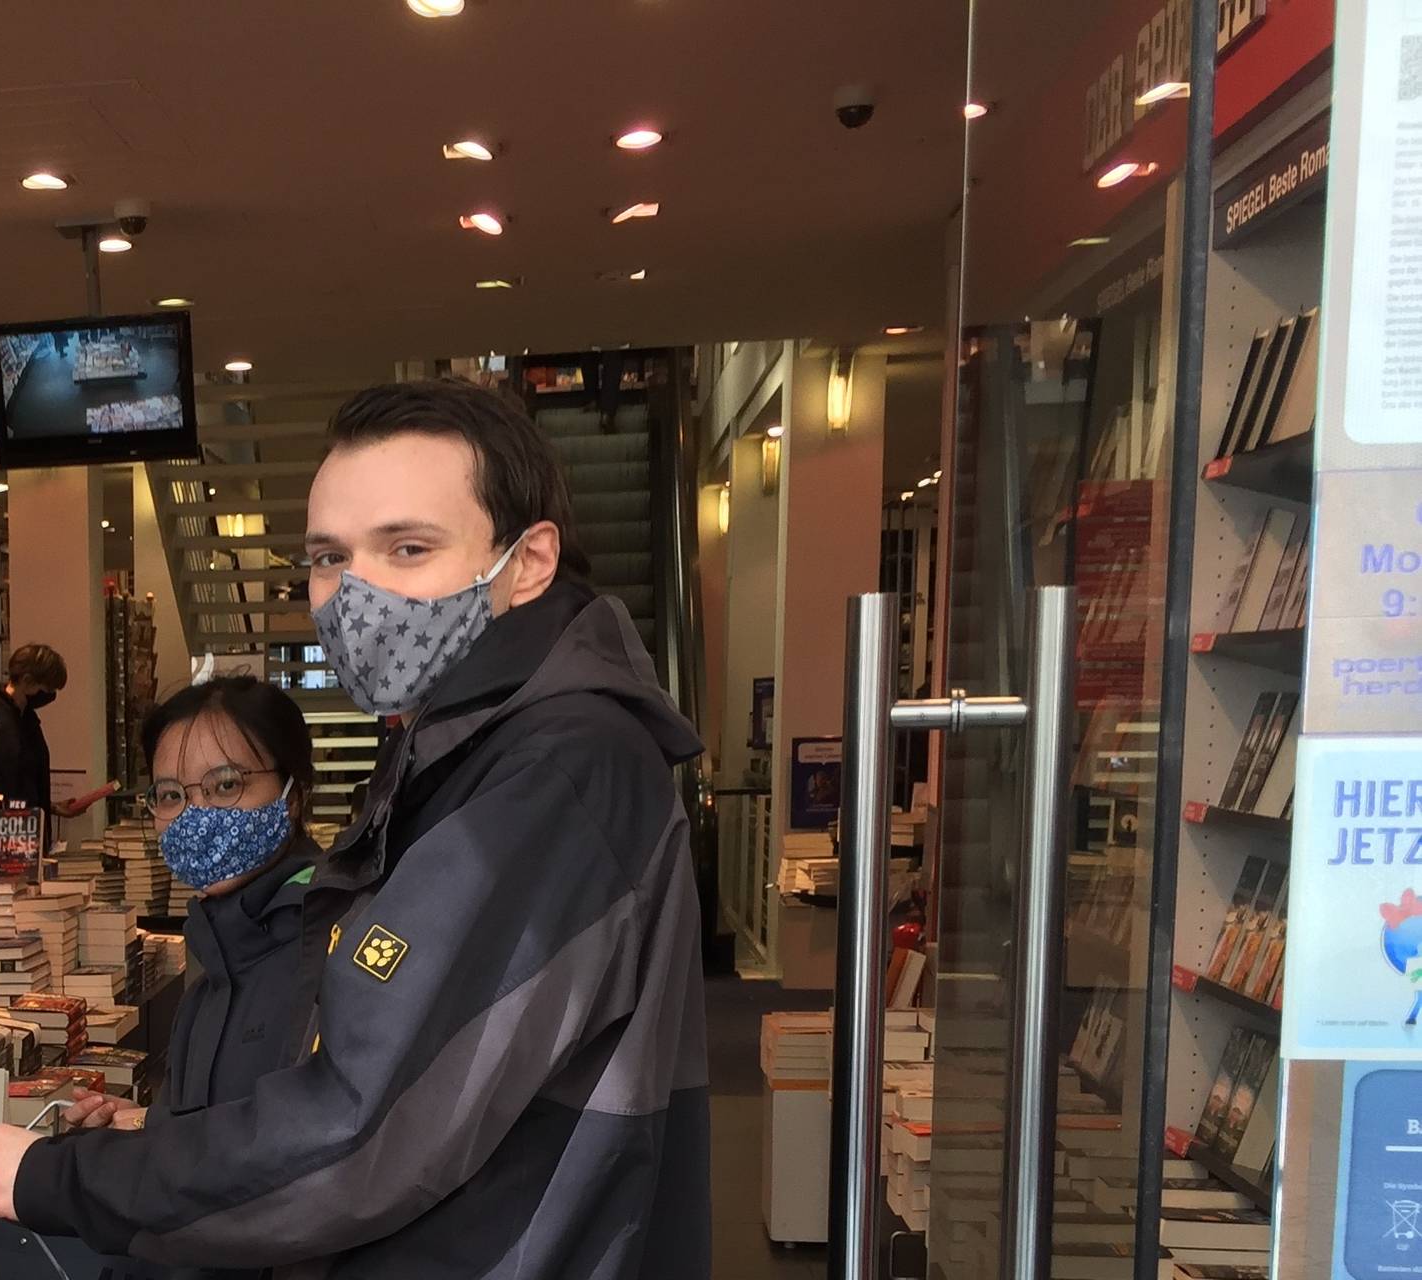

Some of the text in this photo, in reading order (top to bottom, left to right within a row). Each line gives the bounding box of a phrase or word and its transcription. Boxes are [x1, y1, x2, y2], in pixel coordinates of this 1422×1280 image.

[1226, 182, 1266, 235] SPIEGEL
[1268, 163, 1298, 205] Beste
[9, 800, 26, 809] NEU
